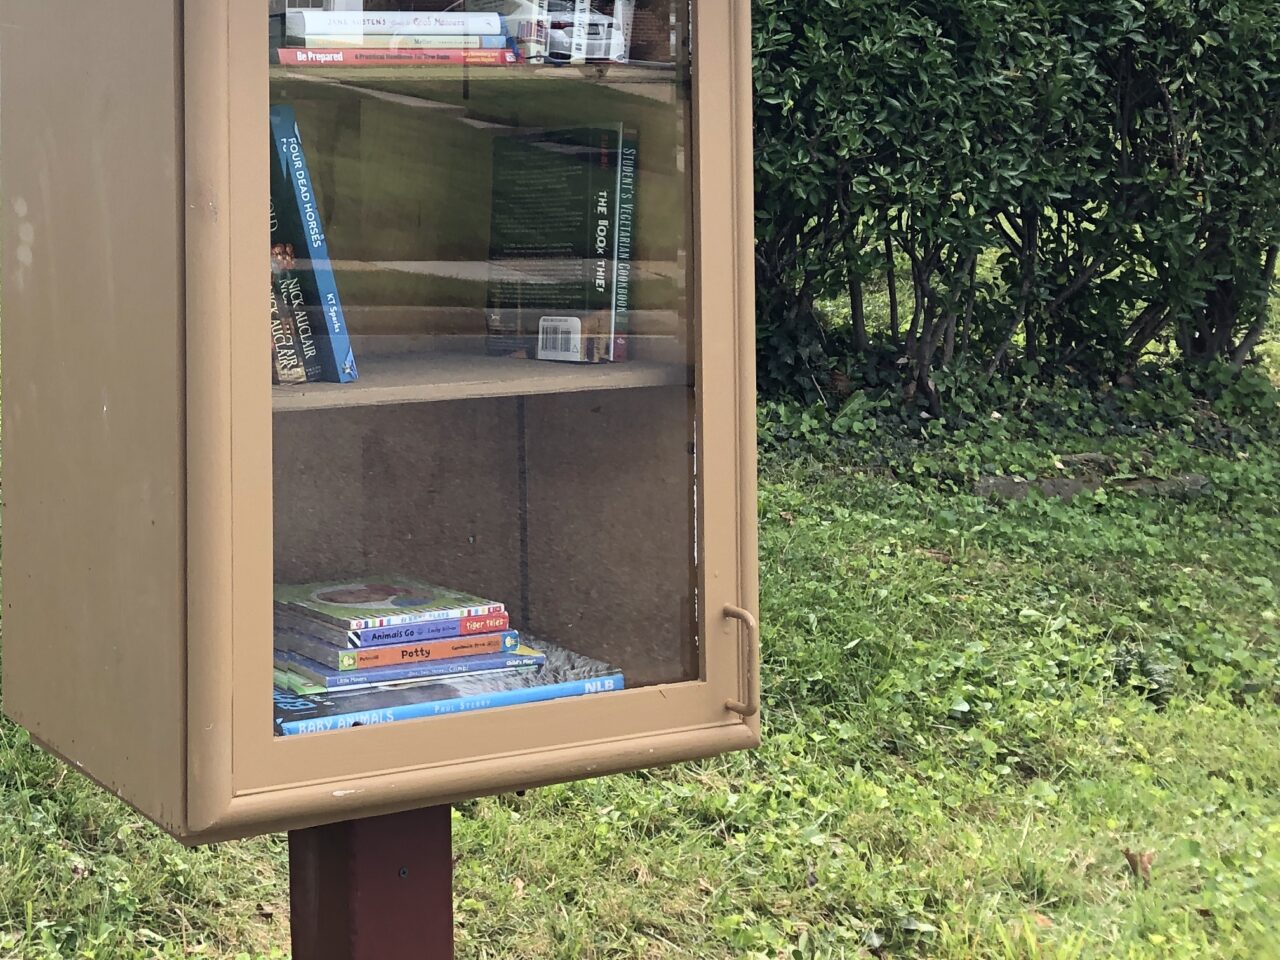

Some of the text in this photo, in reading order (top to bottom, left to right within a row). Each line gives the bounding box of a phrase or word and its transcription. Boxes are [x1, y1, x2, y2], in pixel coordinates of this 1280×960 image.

[296, 51, 307, 61] Be
[307, 51, 344, 64] Prepared
[288, 137, 322, 248] FOUR DEAD HORSES
[597, 190, 608, 215] THE
[616, 148, 637, 313] STUDENT'S VEGETARIAN COOKBOOK
[595, 260, 606, 293] THIEF
[286, 278, 305, 308] NICK
[326, 293, 341, 333] KT Sparks
[294, 311, 317, 360] AUCLAIR
[371, 628, 403, 641] Animals
[404, 628, 415, 638] Go
[466, 620, 485, 630] tiger
[486, 618, 504, 627] tales
[400, 647, 431, 659] Potty
[584, 679, 615, 693] NLB
[298, 711, 395, 735] BABY ANIMALS
